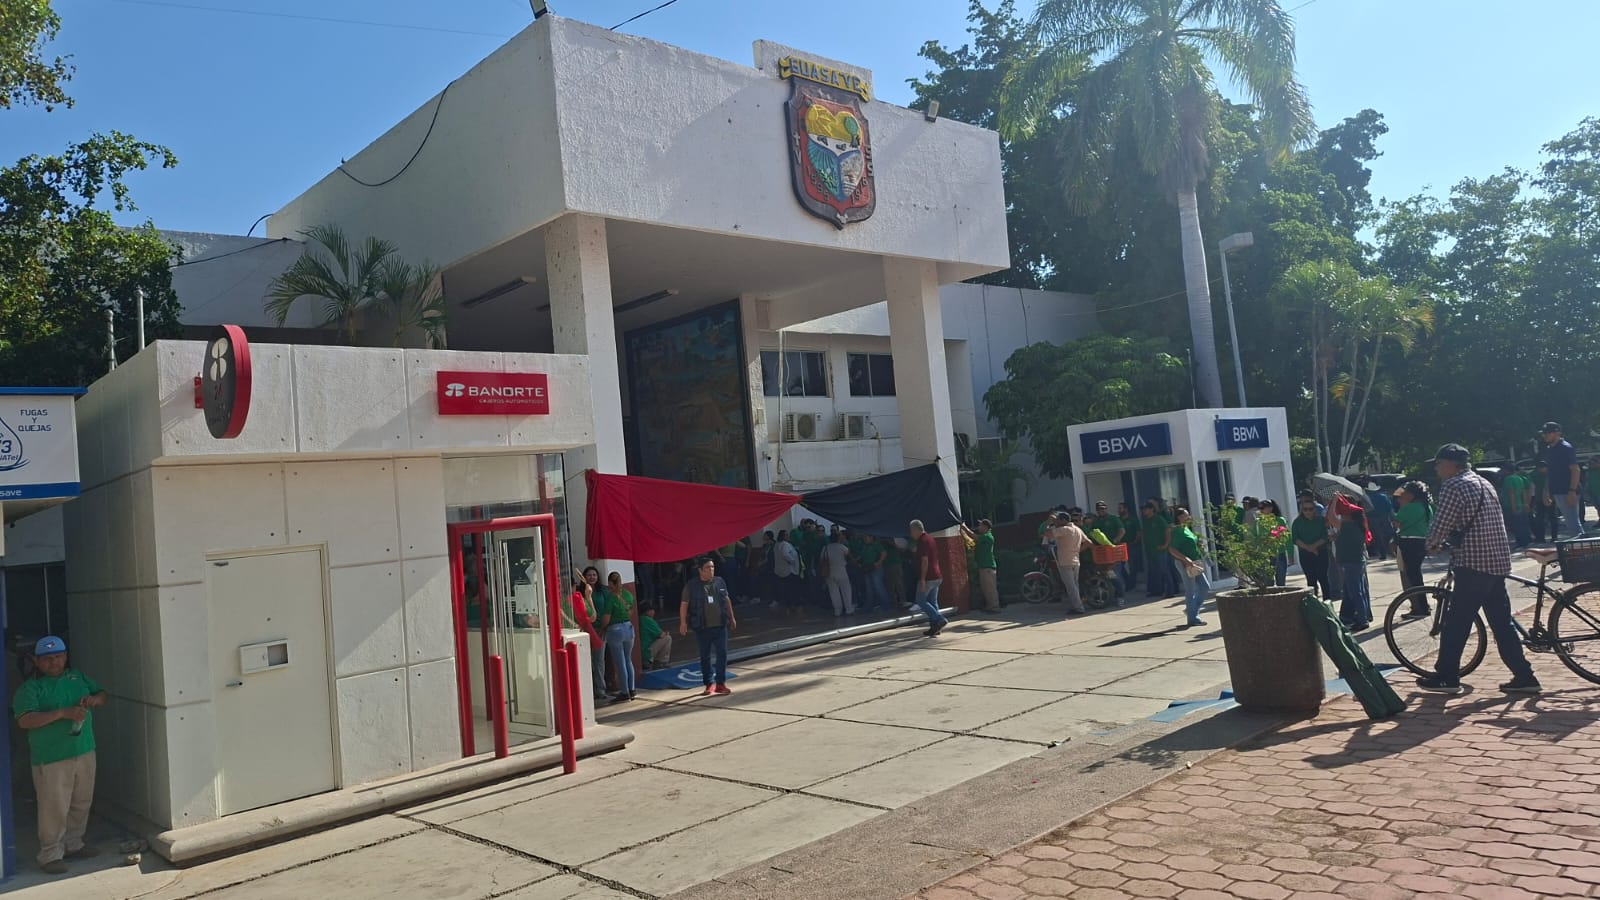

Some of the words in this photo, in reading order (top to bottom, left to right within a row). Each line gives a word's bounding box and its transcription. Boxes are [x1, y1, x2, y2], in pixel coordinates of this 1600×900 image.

[791, 58, 863, 91] GUASAVE
[468, 386, 544, 397] BANORTE
[1233, 425, 1259, 442] BBVA
[0, 440, 12, 453] 3
[1098, 433, 1148, 454] BBVA
